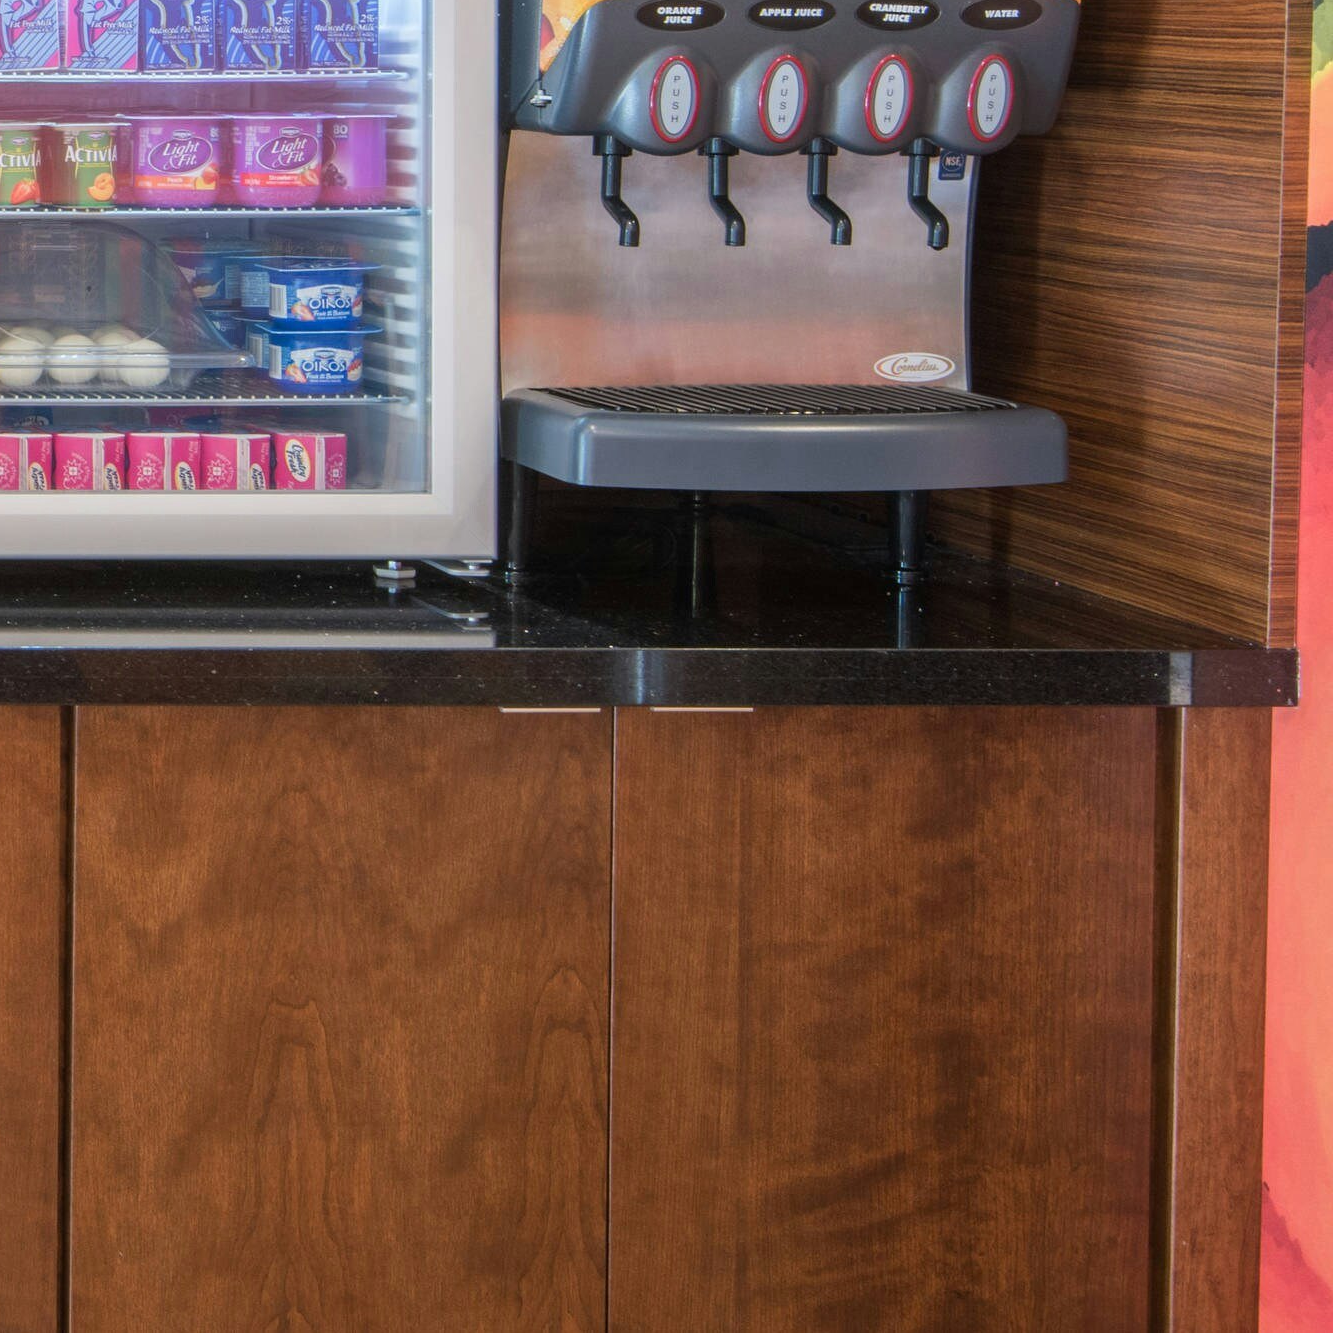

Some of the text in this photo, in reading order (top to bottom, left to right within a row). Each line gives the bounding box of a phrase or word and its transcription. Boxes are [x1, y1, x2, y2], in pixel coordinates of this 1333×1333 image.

[657, 6, 703, 15] ORANGE
[759, 8, 824, 17] APPLE JUICE
[869, 3, 928, 14] CRANBERRY
[985, 9, 1021, 18] WATER
[664, 16, 693, 24] JUICE
[883, 14, 912, 23] JUICE
[670, 75, 681, 123] PUSH
[777, 75, 789, 123] PUSH
[883, 75, 895, 123] PUSH
[985, 74, 997, 122] PUSH
[163, 141, 200, 159] Light
[272, 137, 306, 156] Light
[65, 145, 117, 162] ACTIVIA
[309, 297, 351, 310] OIKOS
[302, 360, 347, 373] OIKOS
